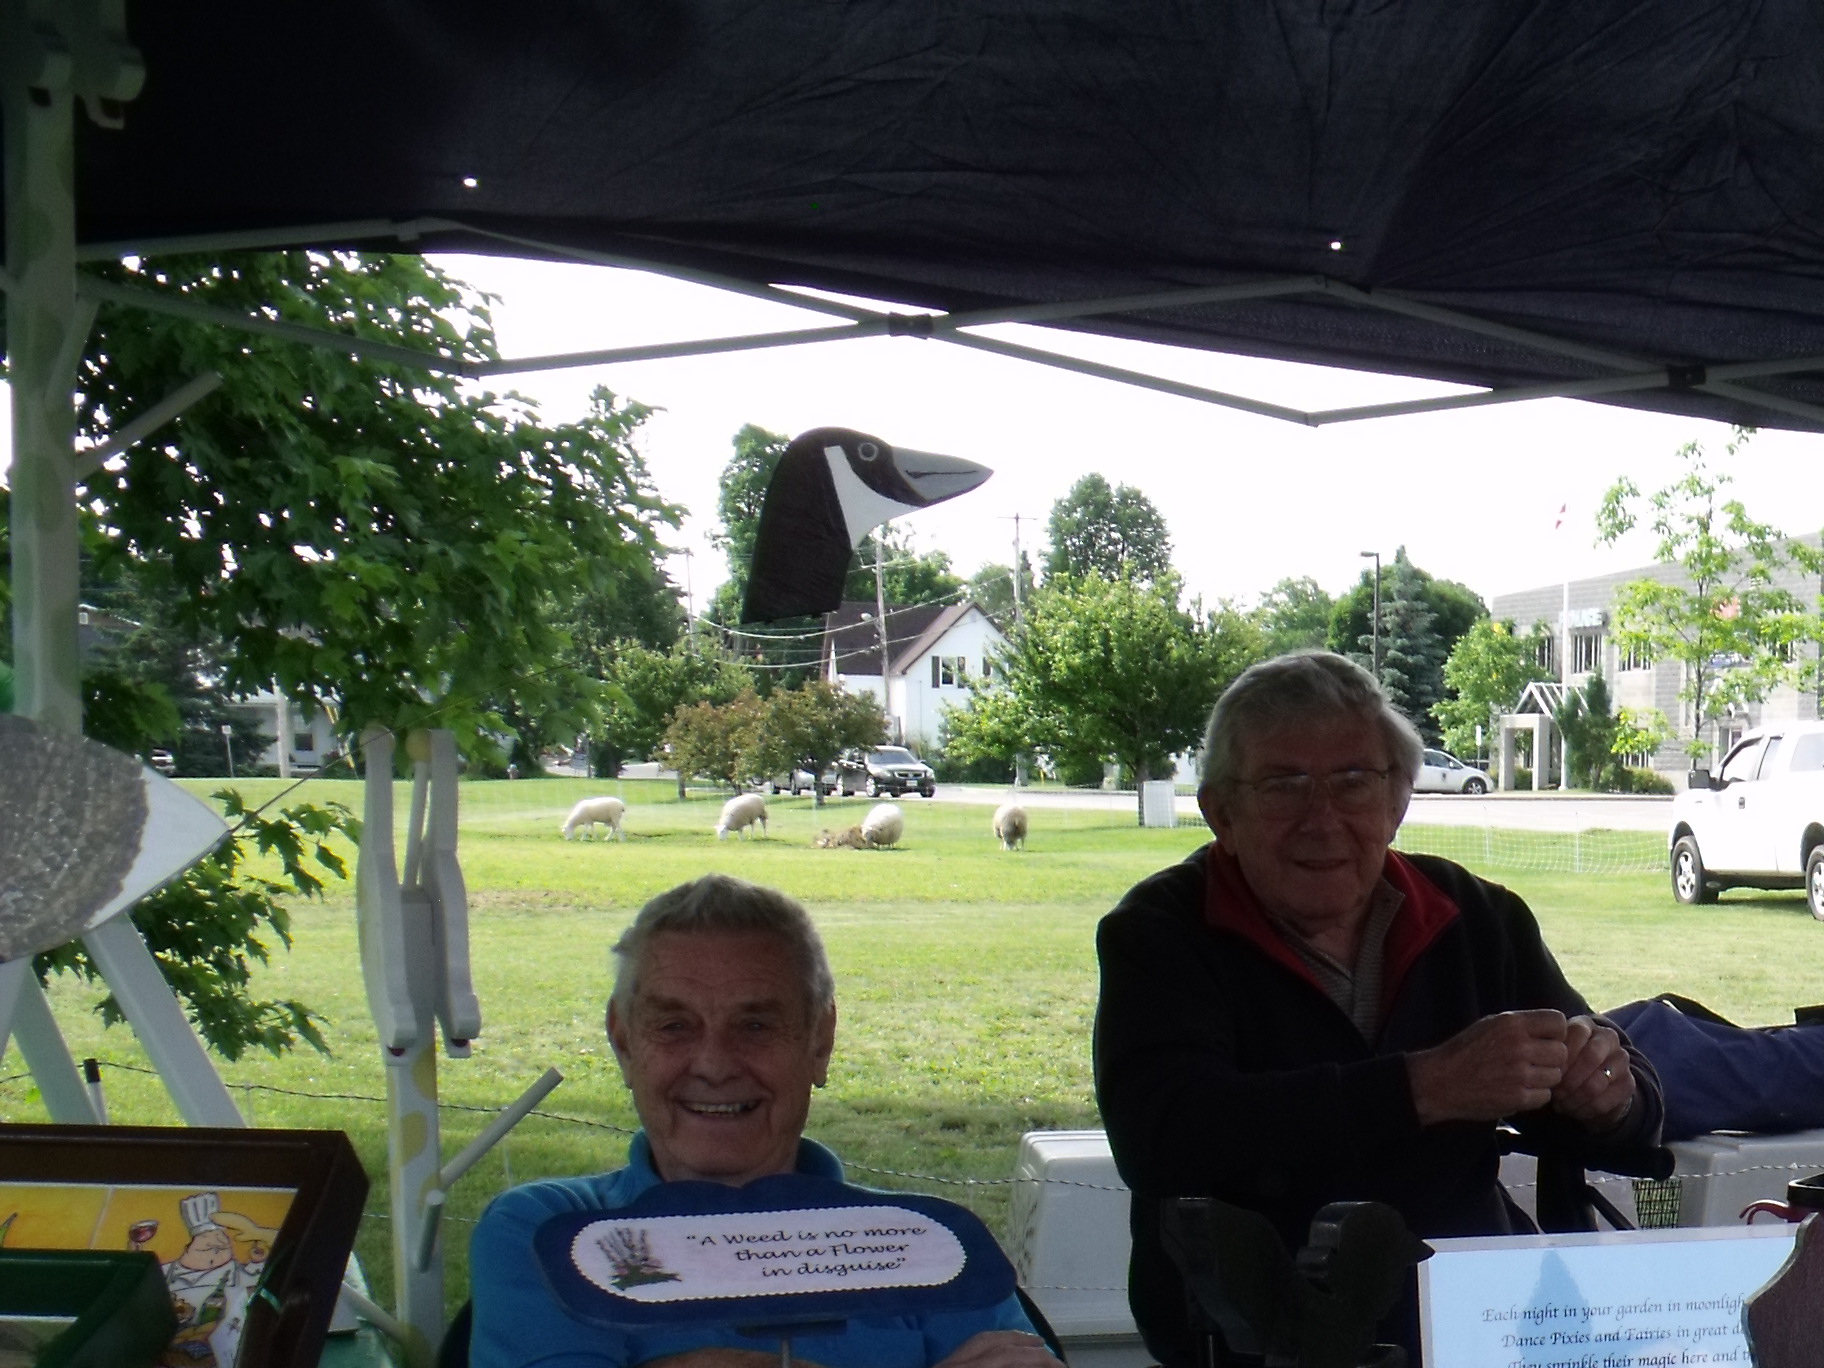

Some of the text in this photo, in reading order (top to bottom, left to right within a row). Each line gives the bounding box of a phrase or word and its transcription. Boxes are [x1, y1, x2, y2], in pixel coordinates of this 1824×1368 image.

[722, 1230, 793, 1245] Weed
[825, 1228, 858, 1239] no
[864, 1225, 927, 1238] more
[735, 1243, 910, 1262] than Flower
[762, 1266, 793, 1278] in
[1482, 1292, 1746, 1326] Each night your garden moonligh
[1500, 1332, 1547, 1349] Dance
[1549, 1327, 1592, 1346] Pixies
[1594, 1325, 1621, 1343] and
[1624, 1324, 1673, 1343] Fairies
[1693, 1321, 1729, 1343] great
[1681, 1347, 1709, 1365] here
[1711, 1344, 1739, 1363] and
